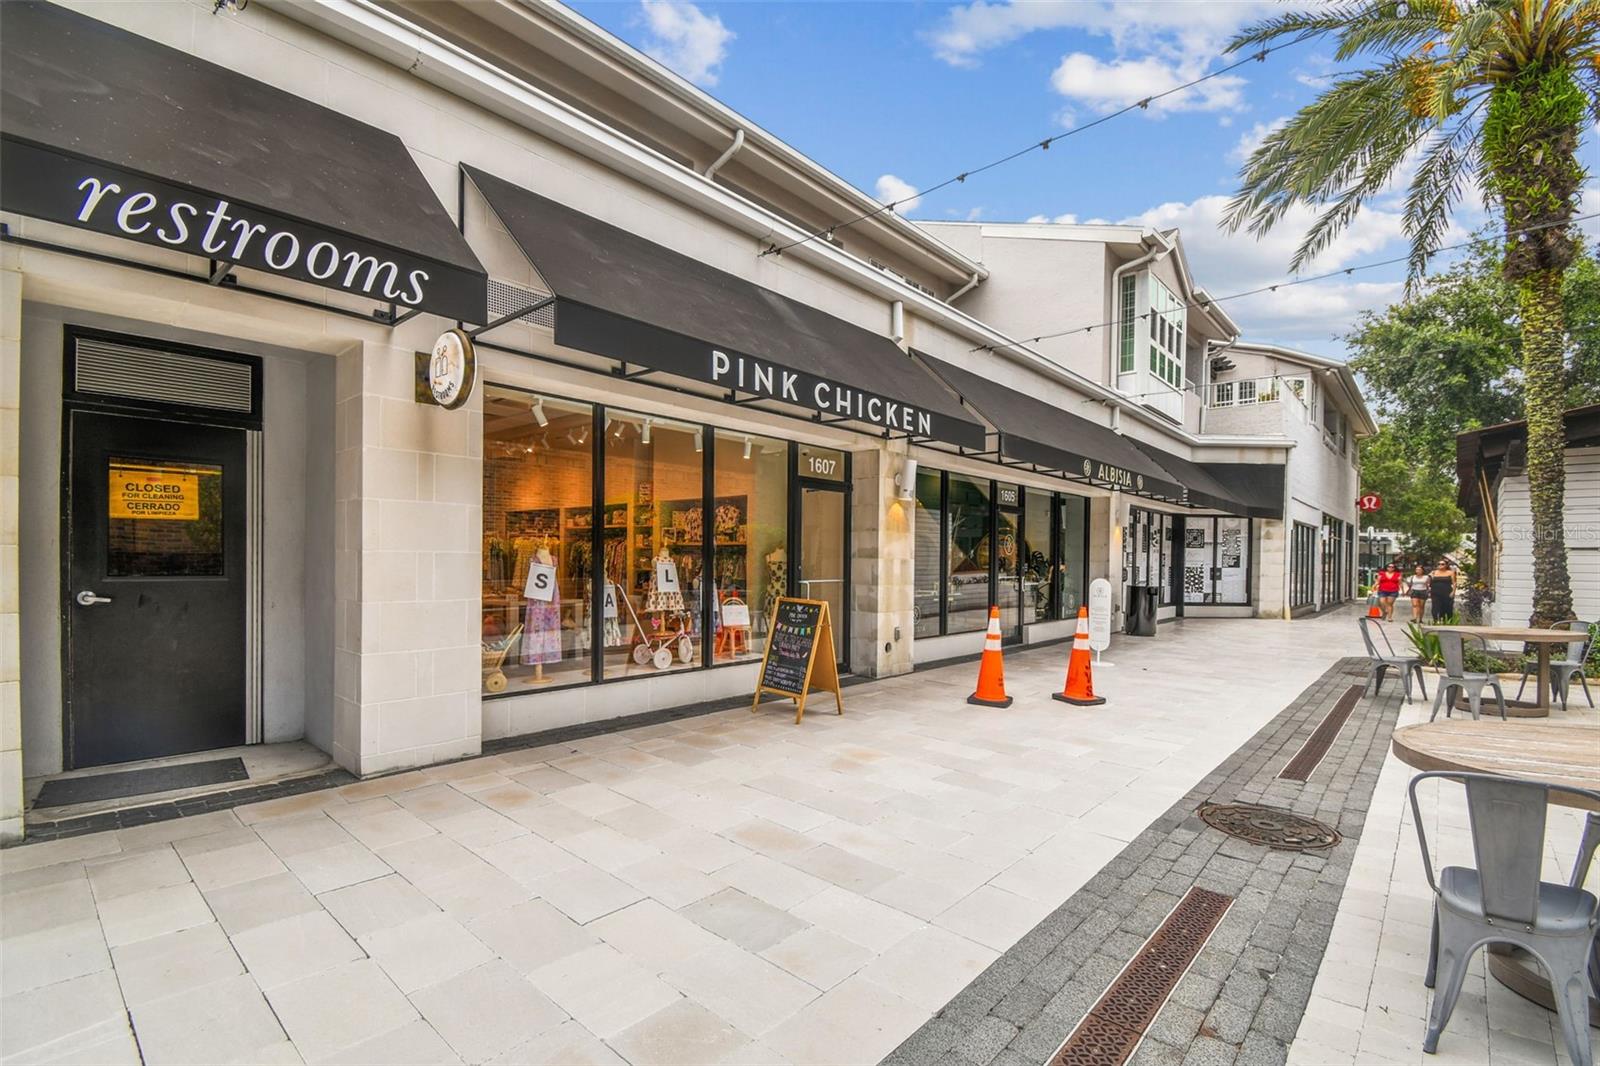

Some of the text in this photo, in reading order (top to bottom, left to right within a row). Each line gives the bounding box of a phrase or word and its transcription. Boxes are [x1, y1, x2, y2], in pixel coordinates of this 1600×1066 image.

[77, 176, 430, 306] restrooms
[711, 349, 931, 436] PINK CHICKEN
[808, 457, 836, 475] 1607
[1097, 463, 1132, 487] ALBISIA
[125, 482, 181, 493] CLOSED
[1000, 490, 1016, 502] 1605
[126, 502, 181, 511] CERRADO
[534, 573, 549, 590] S
[664, 569, 674, 583] L
[604, 592, 613, 608] A
